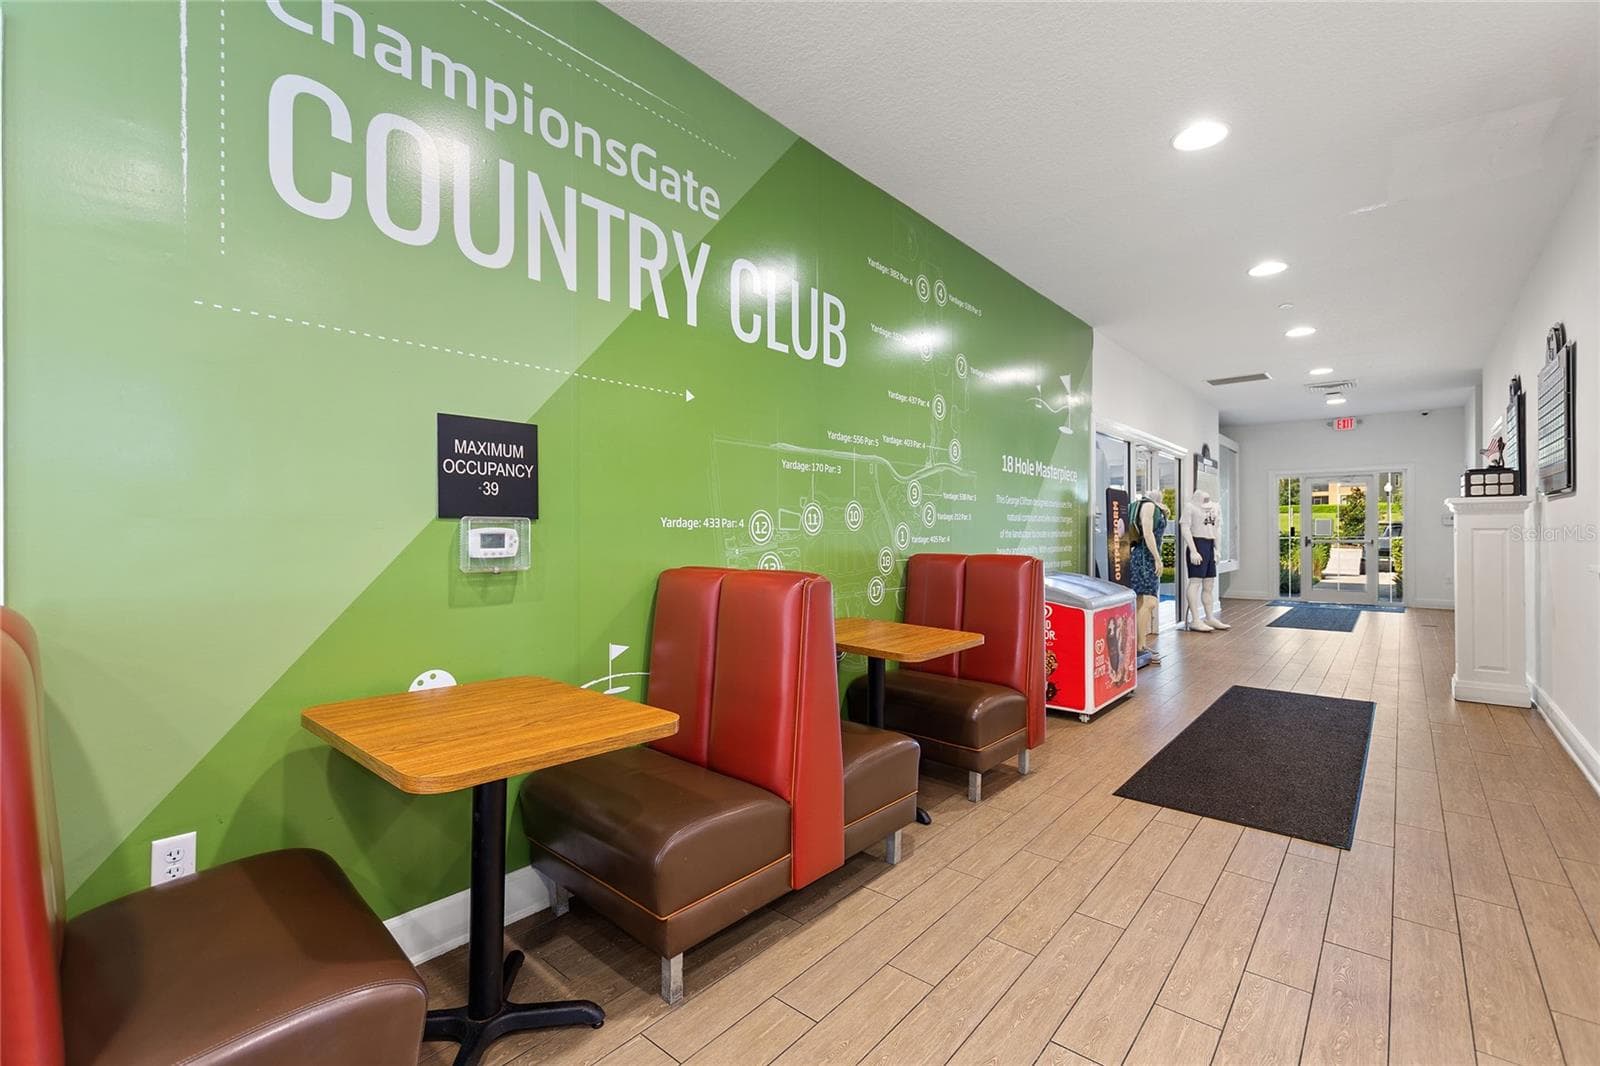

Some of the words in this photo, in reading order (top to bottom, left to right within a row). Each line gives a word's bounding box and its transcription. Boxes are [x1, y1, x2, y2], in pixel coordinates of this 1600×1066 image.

[268, 74, 711, 327] COUNTRY
[729, 258, 847, 369] CLUB
[937, 402, 942, 413] 3
[1336, 418, 1354, 430] EXIT
[827, 430, 851, 444] Yardage:
[852, 435, 864, 445] 556
[864, 437, 874, 446] Par:
[454, 439, 524, 459] MAXIMUM
[443, 459, 534, 478] OCCUPANCY
[782, 459, 811, 472] Yardage:
[812, 462, 824, 472] 170
[824, 464, 837, 473] Par:
[837, 465, 842, 474] 3
[1002, 454, 1014, 473] 18
[1014, 456, 1035, 476] Hole
[1035, 460, 1078, 484] Masterpiece
[482, 481, 499, 496] 39
[808, 513, 818, 526] 11
[850, 510, 858, 522] 10
[660, 517, 702, 530] Yardage:
[703, 517, 721, 529] 433
[721, 518, 737, 529] Par:
[738, 518, 745, 528] 4
[754, 521, 768, 534] 12
[882, 555, 891, 567] 18
[872, 585, 881, 597] 17
